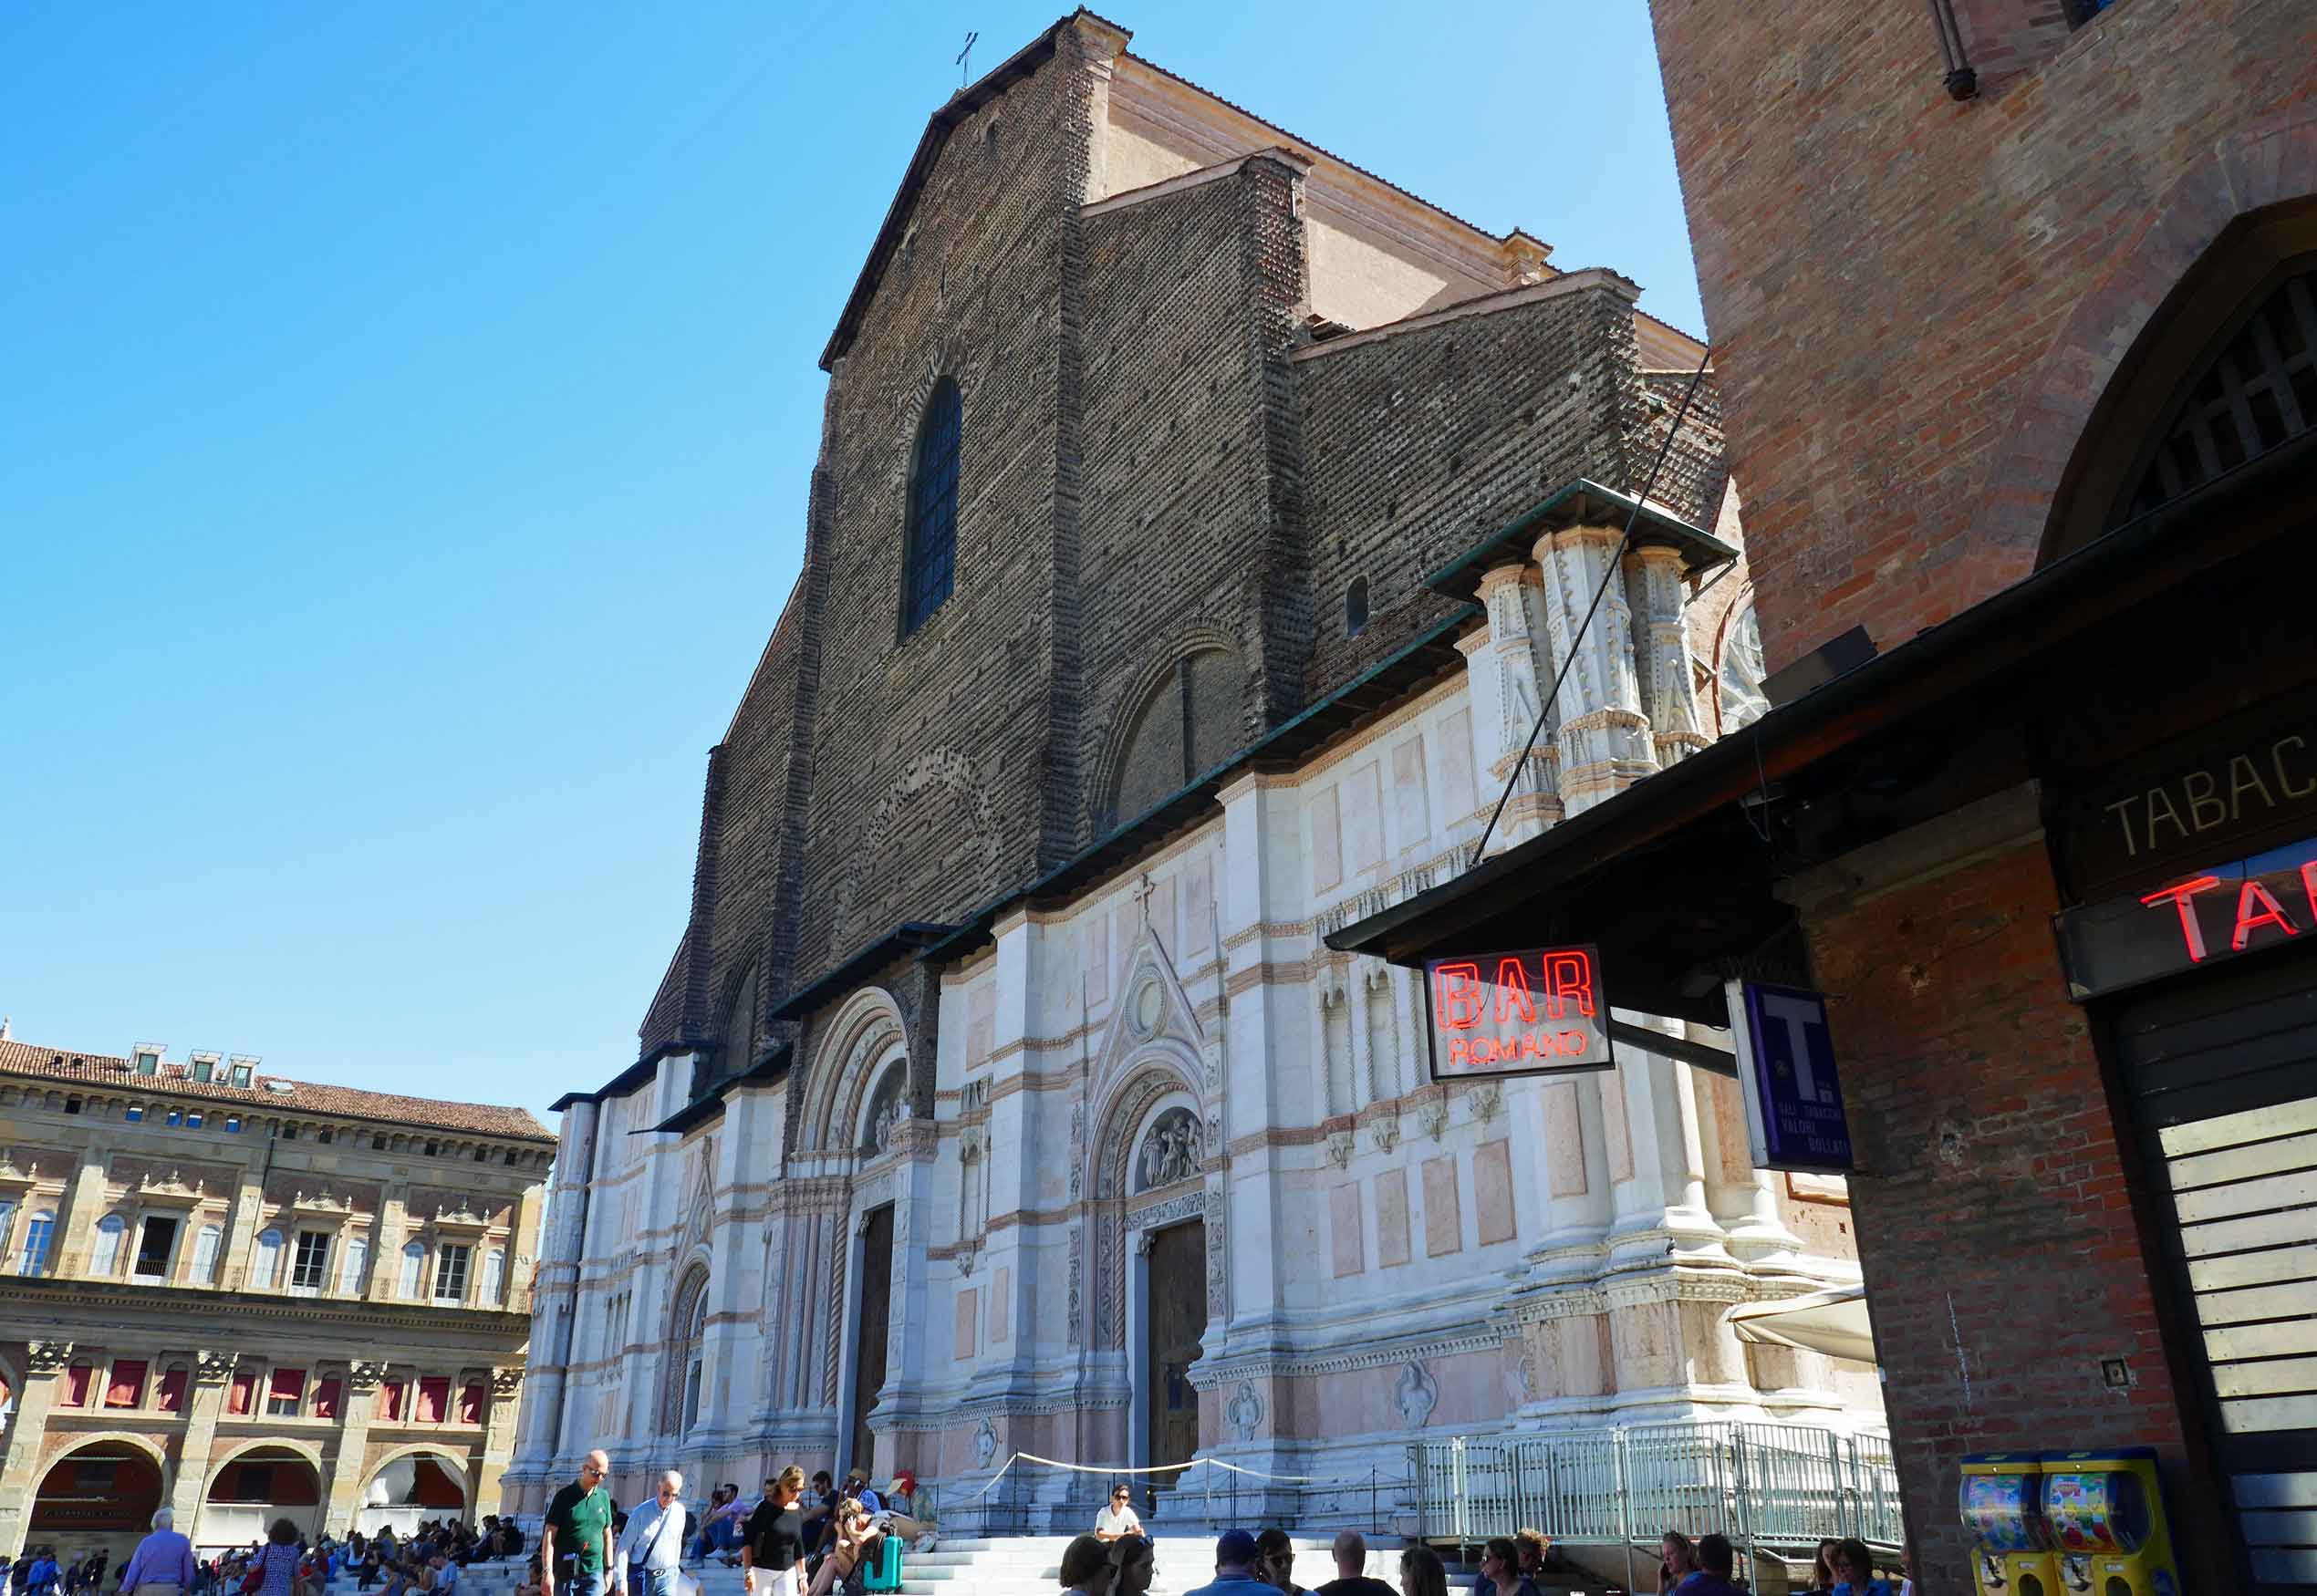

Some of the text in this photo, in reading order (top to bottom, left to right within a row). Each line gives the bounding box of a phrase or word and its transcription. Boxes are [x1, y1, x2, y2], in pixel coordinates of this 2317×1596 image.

[2140, 860, 2317, 963] TA
[1435, 951, 1595, 1030] BAR
[1449, 1030, 1586, 1065] ROMANO
[1761, 994, 1823, 1102] T
